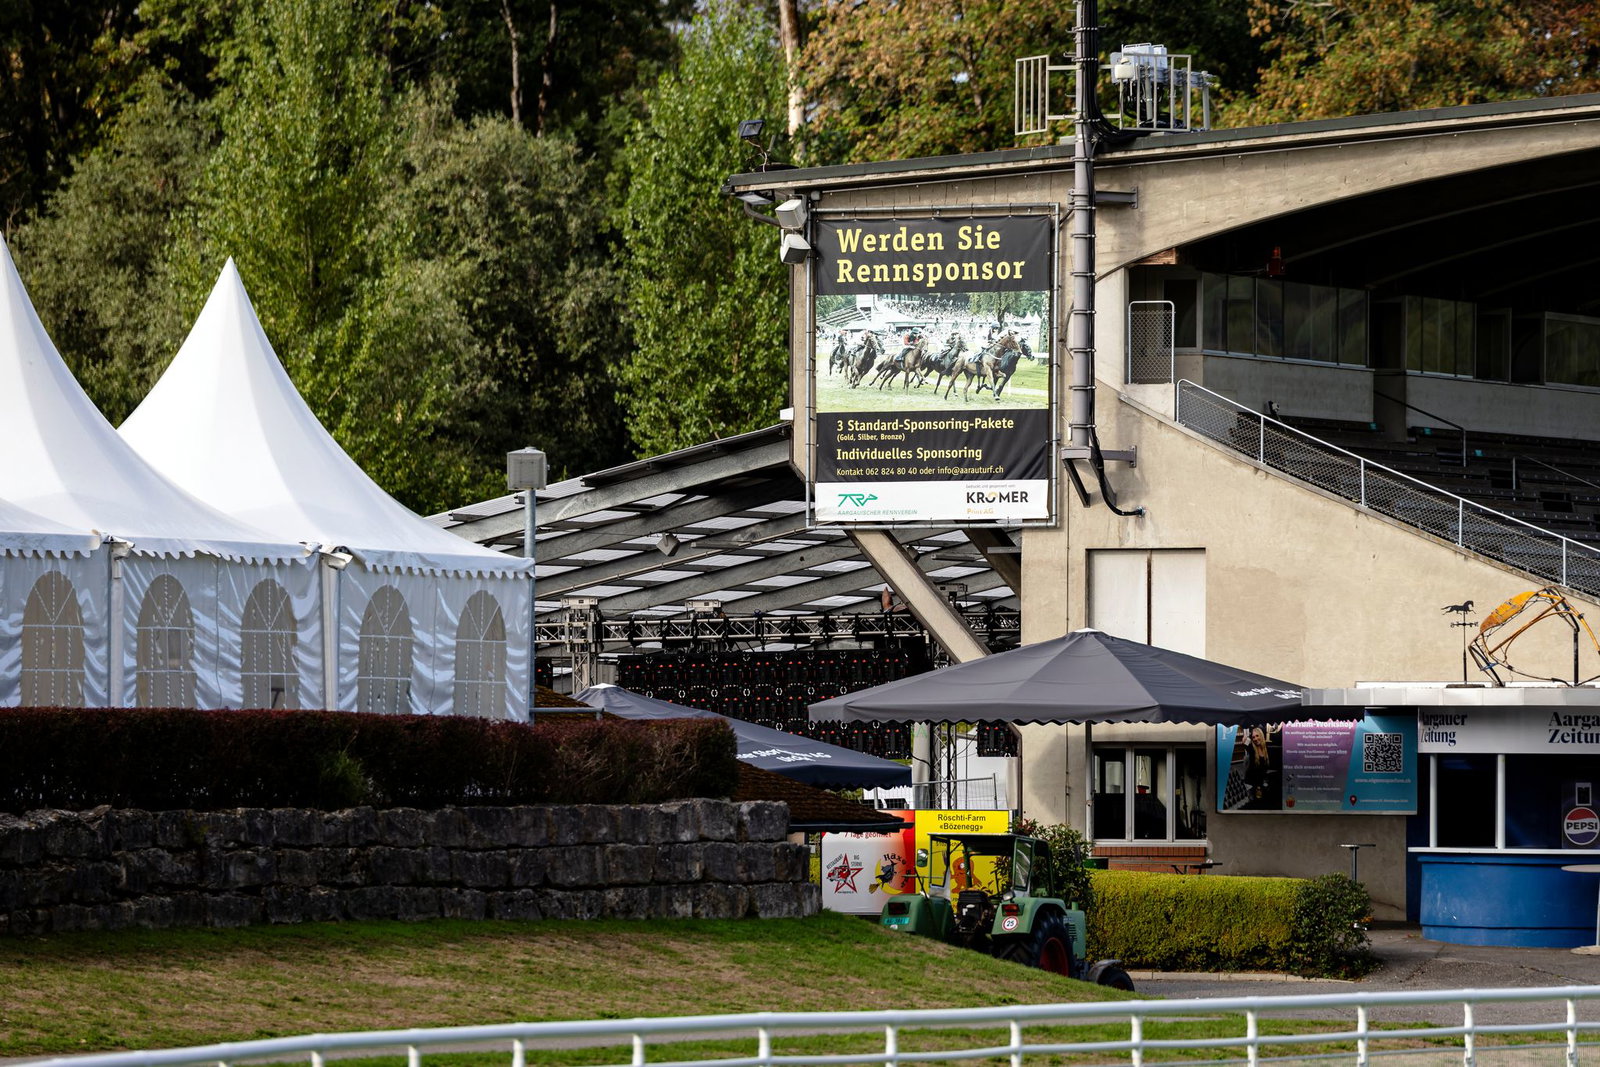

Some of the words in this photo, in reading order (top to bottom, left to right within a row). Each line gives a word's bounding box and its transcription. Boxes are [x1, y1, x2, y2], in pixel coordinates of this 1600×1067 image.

[837, 227, 945, 253] Werden
[958, 225, 1001, 250] Sie
[837, 259, 1025, 287] Rennsponsor
[837, 420, 844, 431] 3
[848, 418, 1014, 432] Standard-Sponsoring-Pakete
[837, 434, 856, 442] (Gold,
[858, 433, 878, 442] Silber,
[880, 432, 906, 442] Bronze)
[837, 448, 912, 460] Individuelles
[916, 447, 982, 462] Sponsoring
[837, 467, 864, 476] Kontakt
[866, 467, 879, 476] 062
[881, 466, 894, 476] 824
[896, 466, 906, 475] 80
[908, 466, 918, 475] 40
[920, 466, 935, 475] oder
[938, 465, 1004, 476] info@aarauturf.ch
[966, 491, 1028, 504] KROMER
[940, 823, 984, 831] «Bözenegg»
[1566, 822, 1598, 830] PEPSI
